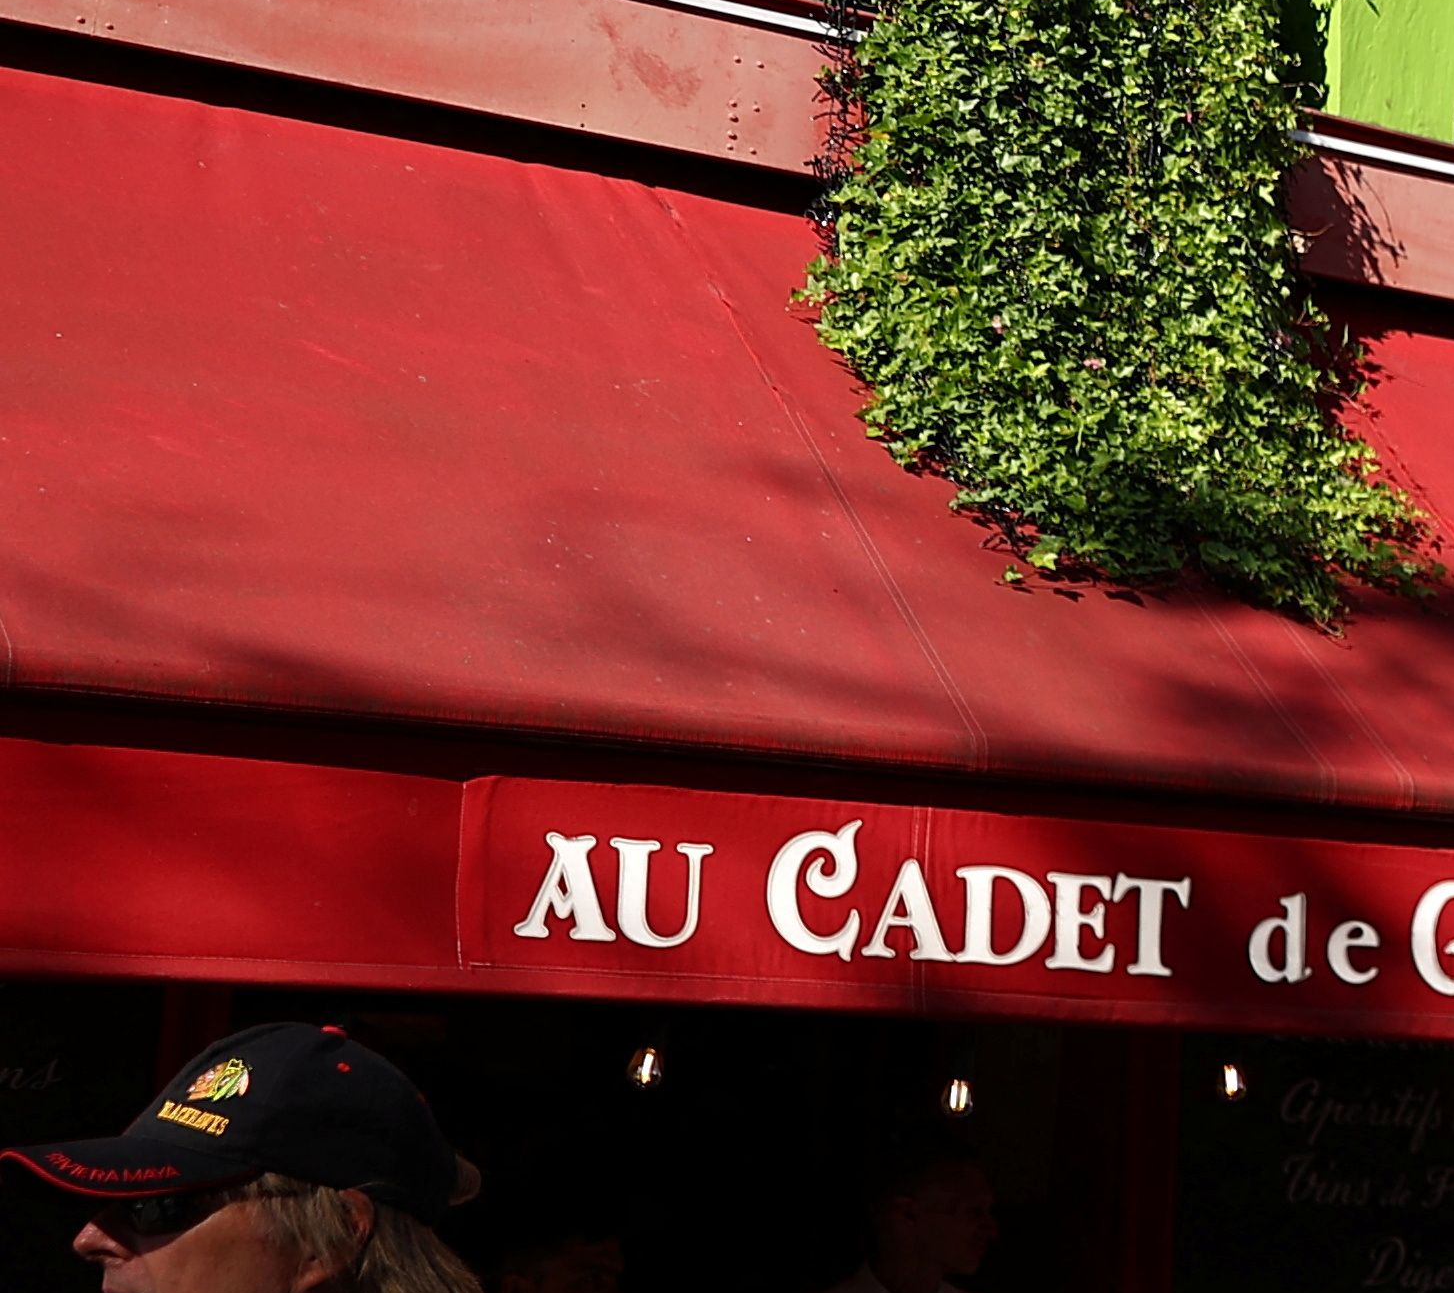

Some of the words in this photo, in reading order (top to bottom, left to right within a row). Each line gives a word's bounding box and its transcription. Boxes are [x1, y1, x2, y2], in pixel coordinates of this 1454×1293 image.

[512, 829, 715, 949] AU
[765, 818, 1192, 978] CADET
[1247, 892, 1382, 986] de
